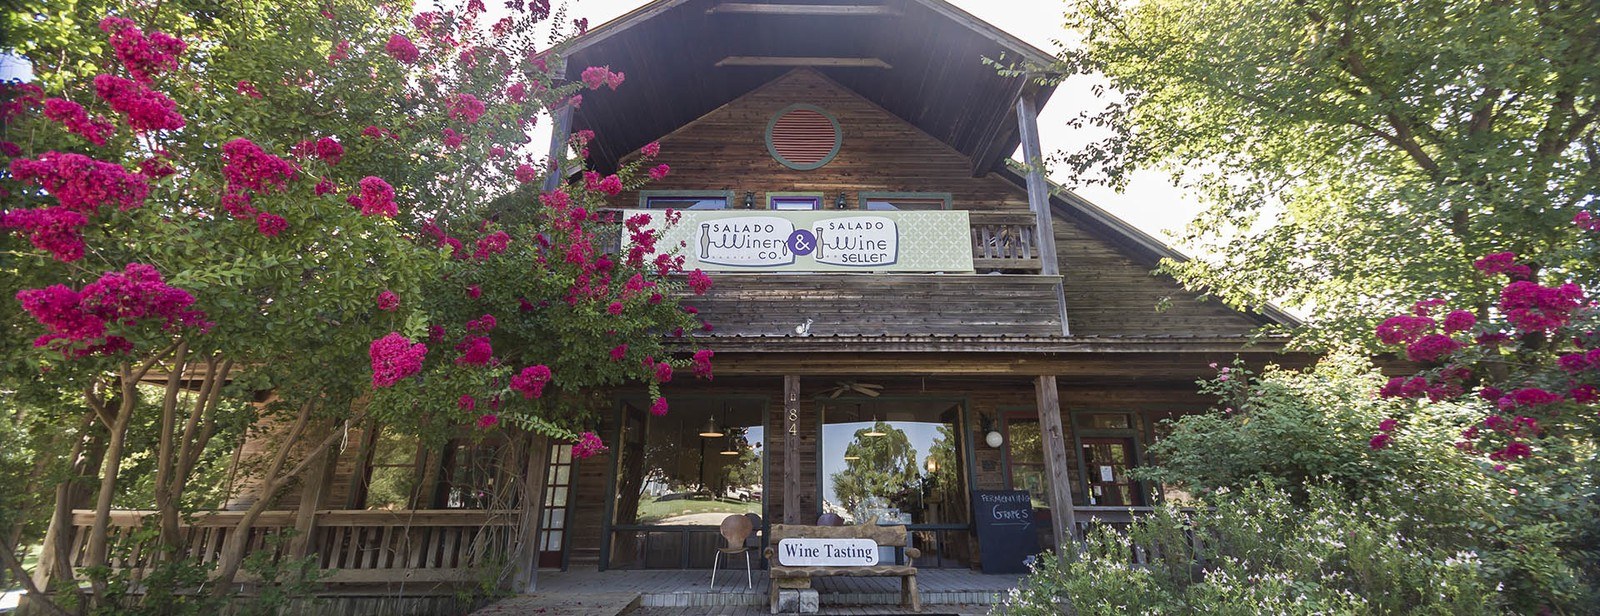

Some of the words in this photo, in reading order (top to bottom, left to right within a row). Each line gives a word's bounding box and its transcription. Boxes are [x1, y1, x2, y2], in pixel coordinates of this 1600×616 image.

[712, 223, 774, 233] SALADO
[829, 221, 884, 230] SALADO
[794, 233, 810, 251] &
[825, 234, 888, 251] Wine
[758, 251, 782, 260] CO.
[784, 542, 820, 558] Wine
[823, 542, 873, 563] Tasting
